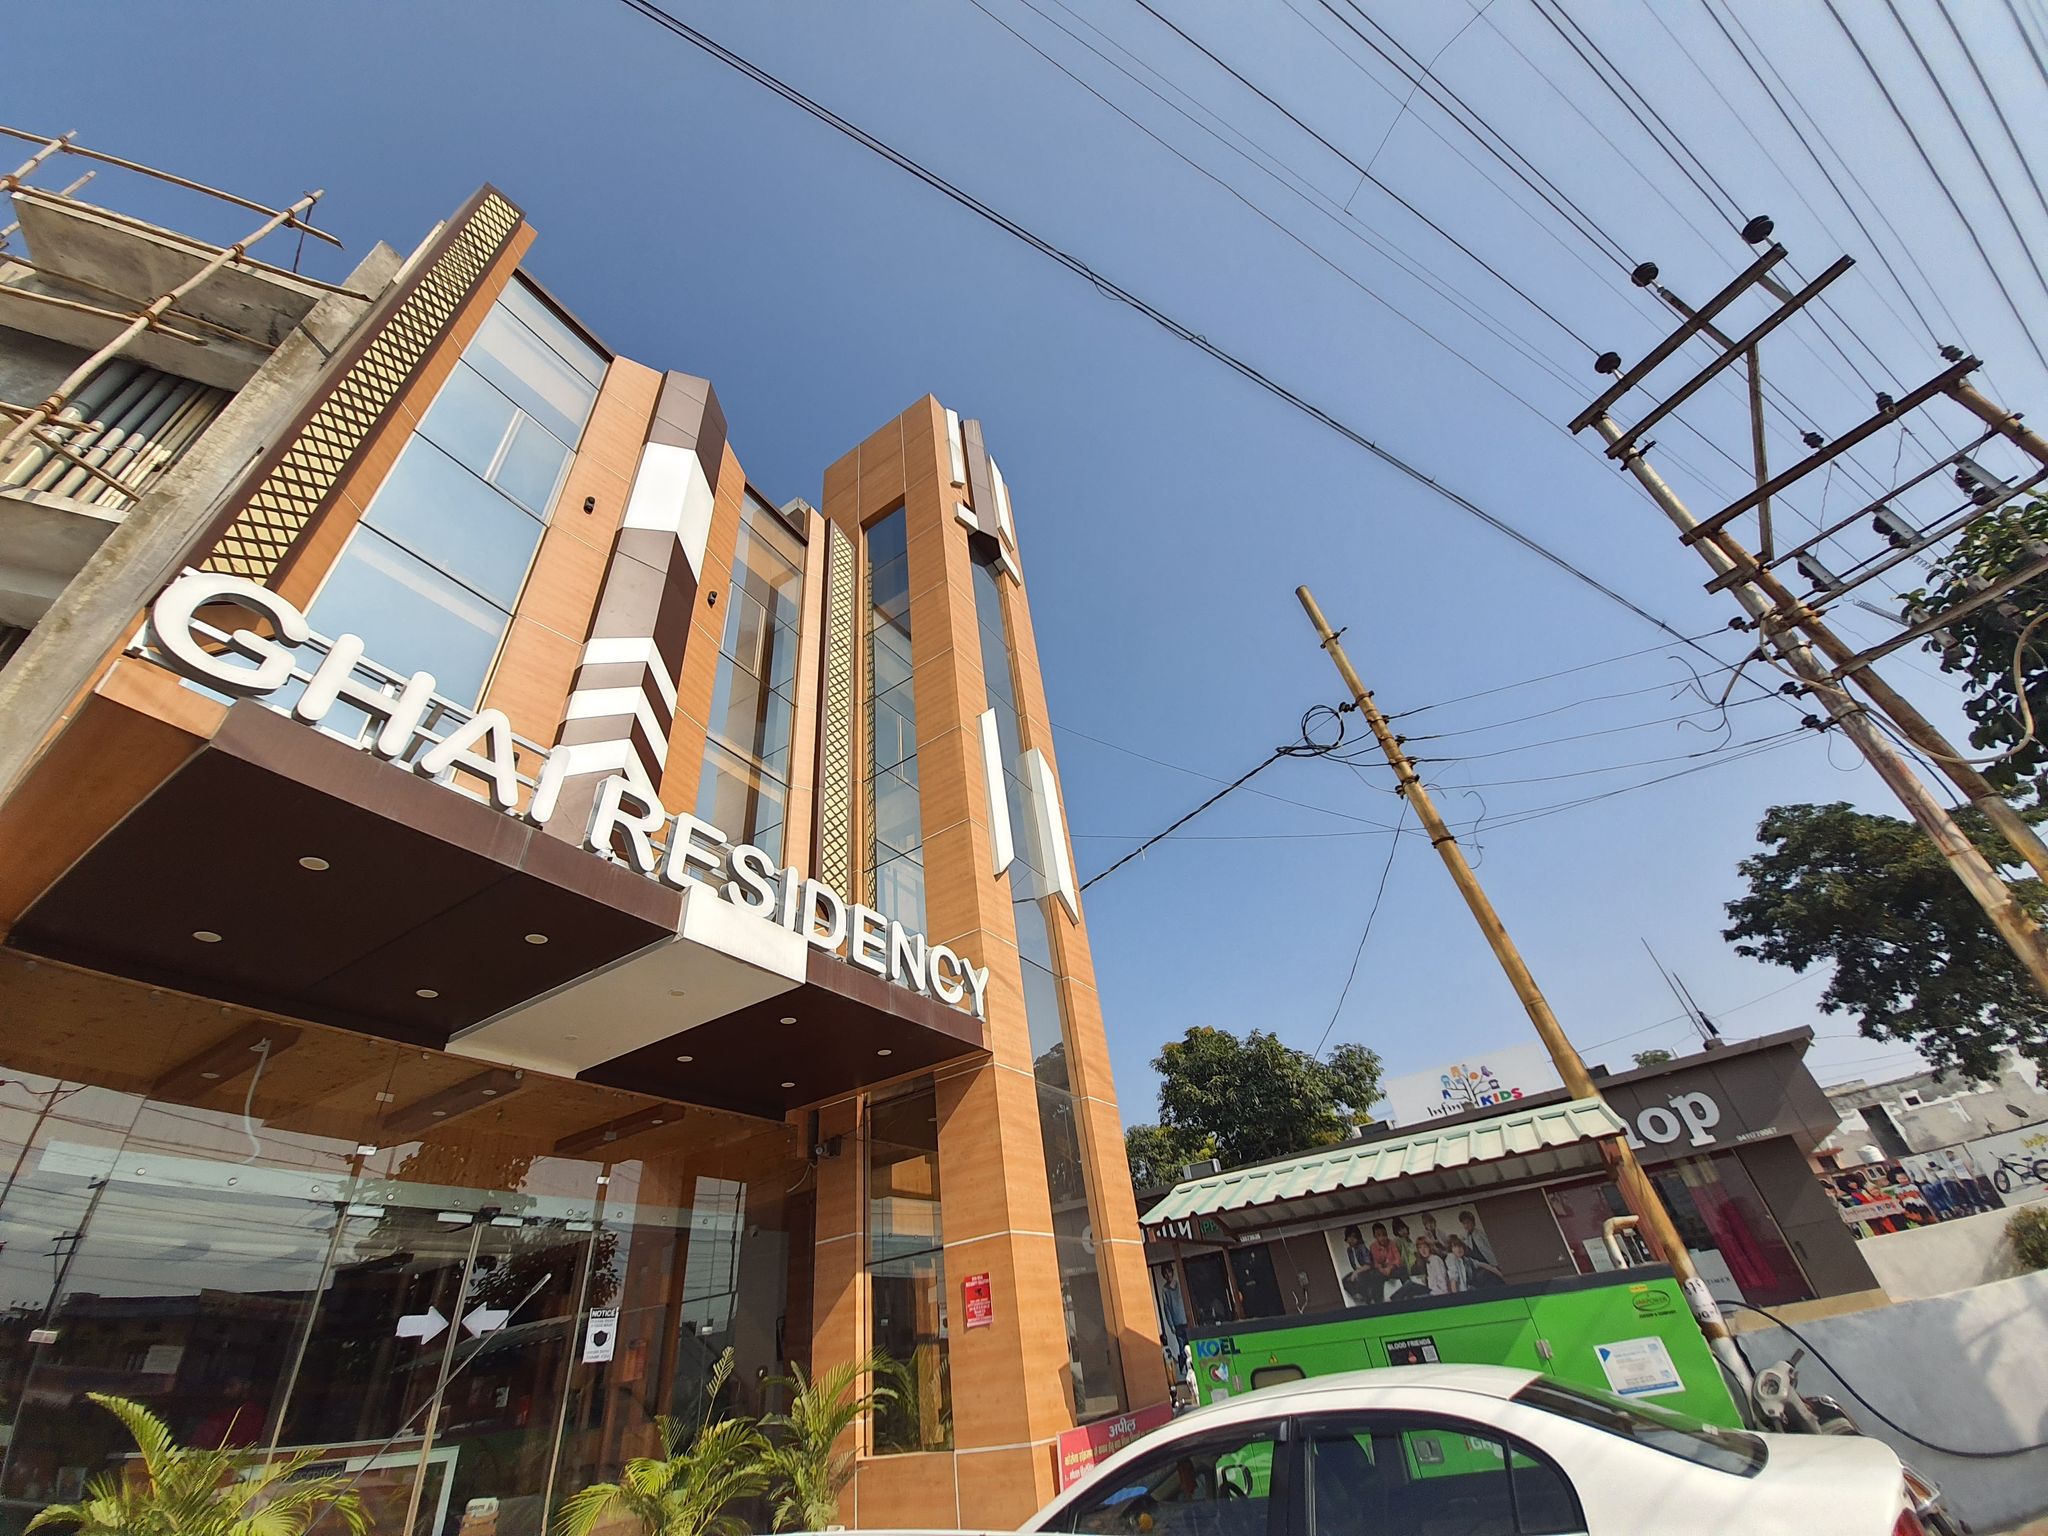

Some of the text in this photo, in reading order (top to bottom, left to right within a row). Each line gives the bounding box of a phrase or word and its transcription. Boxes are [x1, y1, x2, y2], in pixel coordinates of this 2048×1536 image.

[152, 572, 990, 1019] GHAI RESIDENCY
[1479, 1087, 1523, 1106] KIDS
[592, 1308, 616, 1318] NOTICE
[1195, 1336, 1242, 1358] KOEL
[1108, 1417, 1137, 1438] अपील
